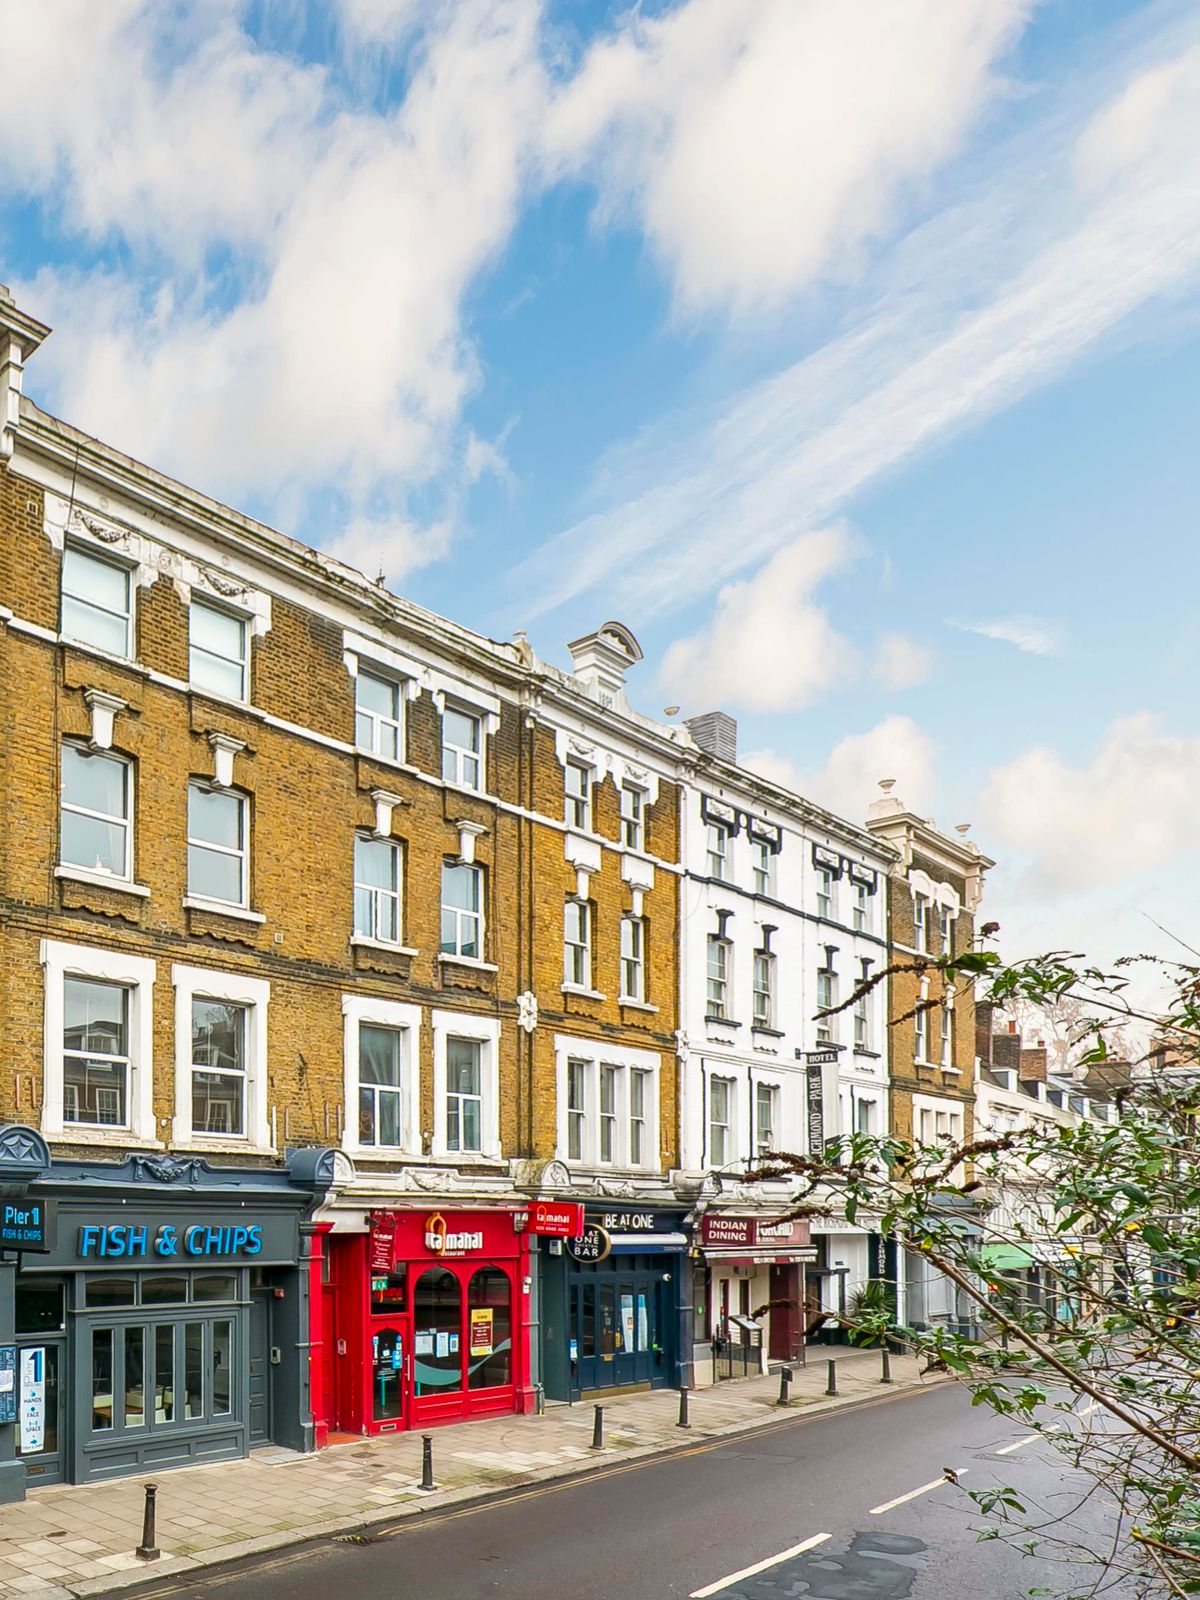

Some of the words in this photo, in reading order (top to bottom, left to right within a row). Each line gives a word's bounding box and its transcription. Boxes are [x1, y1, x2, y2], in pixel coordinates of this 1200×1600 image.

[809, 1053, 834, 1063] HOTEL
[809, 1076, 822, 1100] PARK
[810, 1113, 823, 1155] ICHMOND
[5, 1206, 30, 1225] Pier
[31, 1207, 39, 1225] 1
[546, 1214, 570, 1224] mahal
[605, 1214, 618, 1229] BE
[620, 1214, 631, 1226] AT
[632, 1214, 654, 1229] ONE
[709, 1220, 748, 1231] INDIAN
[2, 1228, 16, 1239] FISH
[23, 1229, 42, 1241] CHIPS
[78, 1225, 147, 1257] FISH
[154, 1225, 178, 1256] &
[184, 1225, 263, 1255] CHIPS
[446, 1232, 483, 1249] mahal
[575, 1236, 599, 1245] ONE
[708, 1230, 747, 1241] DINING
[574, 1247, 599, 1257] BAR
[878, 1235, 886, 1274] ICHMOND
[25, 1425, 41, 1433] SPACE
